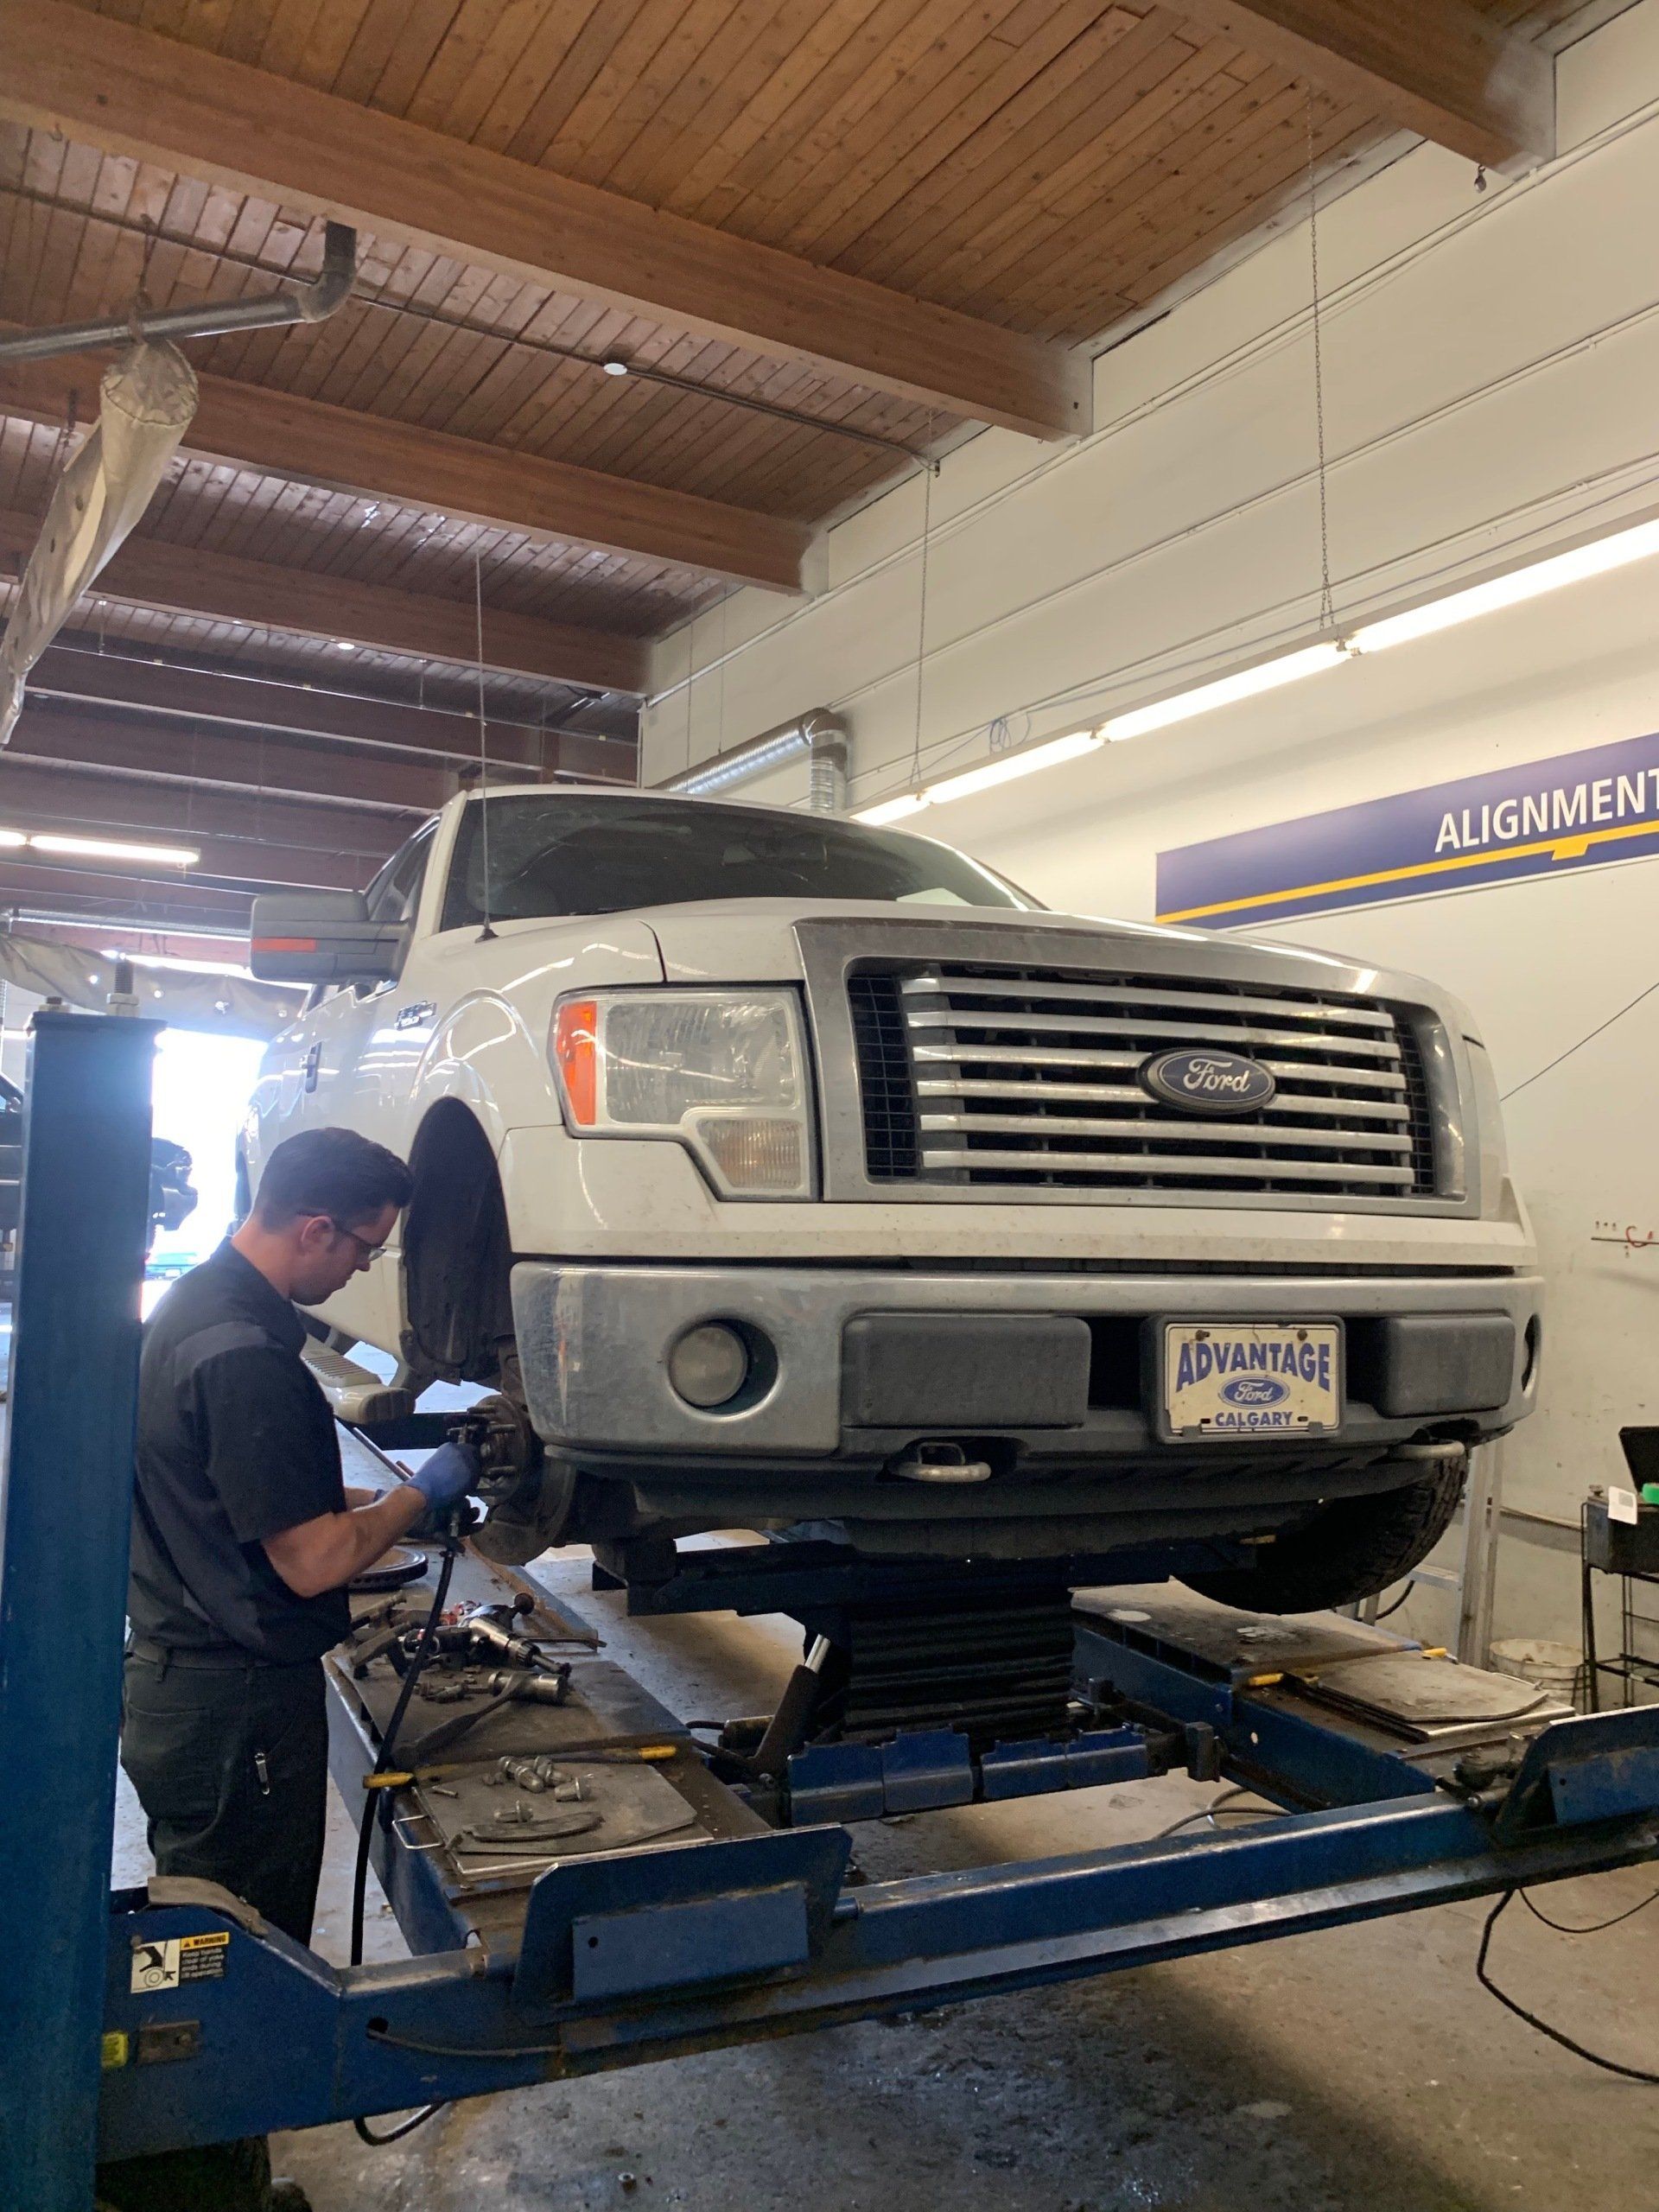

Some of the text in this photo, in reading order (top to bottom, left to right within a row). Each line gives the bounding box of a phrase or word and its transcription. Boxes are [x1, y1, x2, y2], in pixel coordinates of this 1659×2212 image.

[1183, 1058, 1251, 1093] Ford
[1175, 1342, 1331, 1394] ADVANTAGE
[1233, 1381, 1273, 1402] Ford
[1215, 1410, 1293, 1427] CALGARY
[193, 1935, 226, 1947] WARNING
